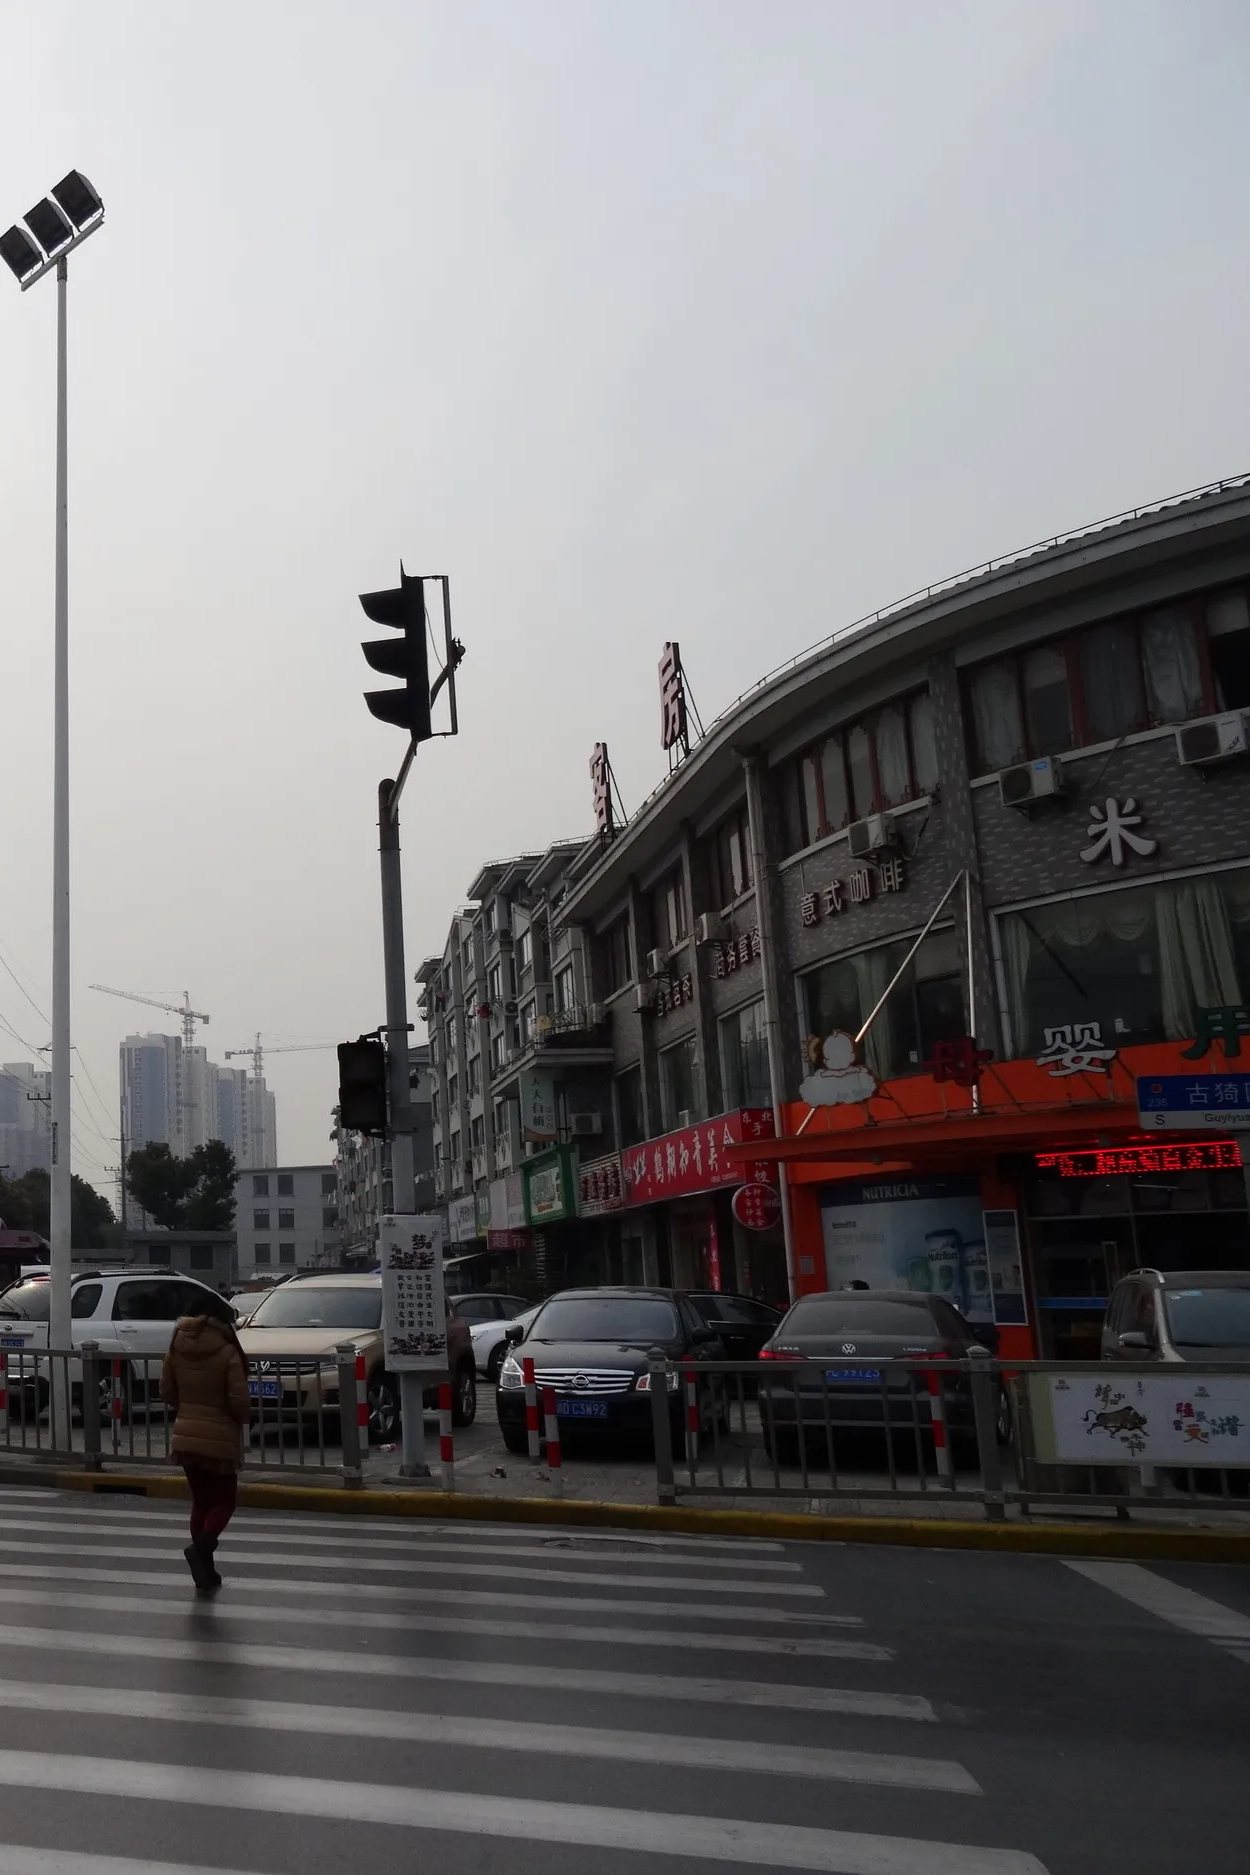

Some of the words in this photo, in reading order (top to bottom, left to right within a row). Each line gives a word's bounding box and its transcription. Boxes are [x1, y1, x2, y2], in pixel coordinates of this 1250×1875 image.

[1078, 797, 1158, 866] 米
[799, 857, 906, 928] 意式咖啡
[1185, 1081, 1250, 1105] 古猗
[1154, 1114, 1166, 1126] S
[862, 1184, 919, 1200] NUTRICIA
[492, 1233, 527, 1249] 超市
